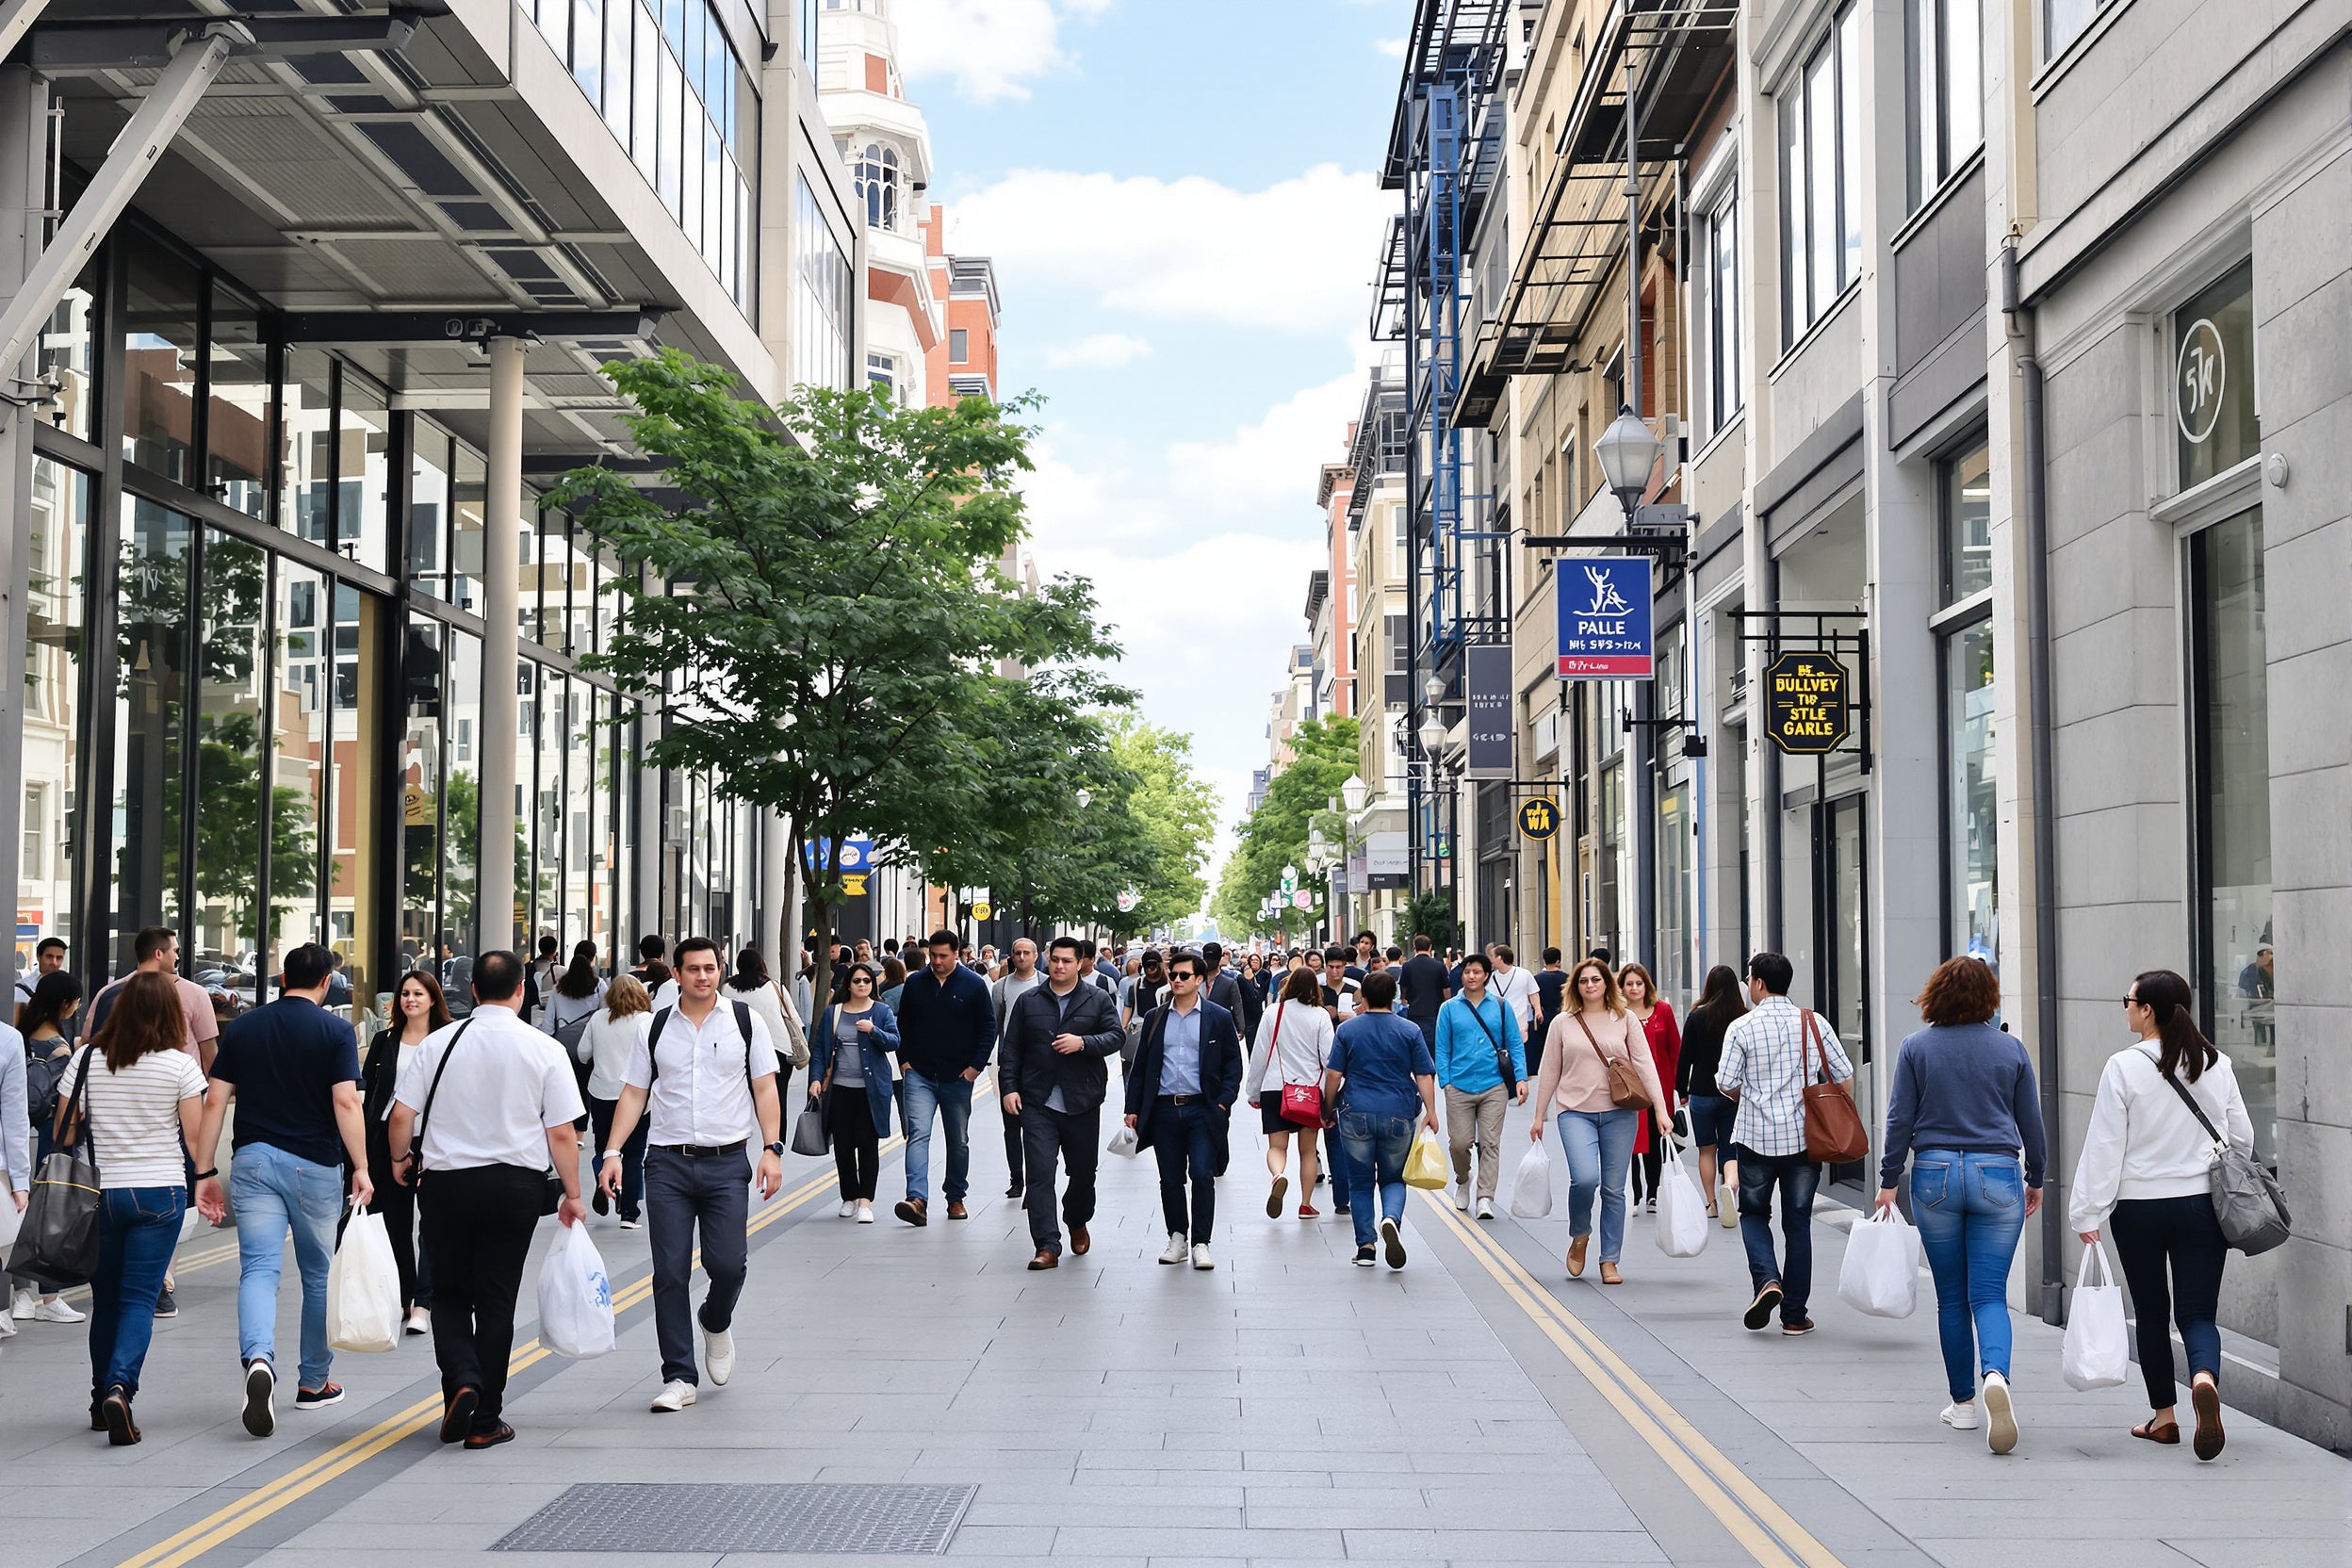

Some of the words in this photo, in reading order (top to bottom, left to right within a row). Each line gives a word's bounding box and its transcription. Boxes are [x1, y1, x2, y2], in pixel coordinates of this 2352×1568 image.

[1578, 621, 1625, 635] PALLE
[1775, 678, 1838, 693] BULLVEY
[1789, 708, 1827, 721] STLE
[1783, 721, 1834, 736] GARLE
